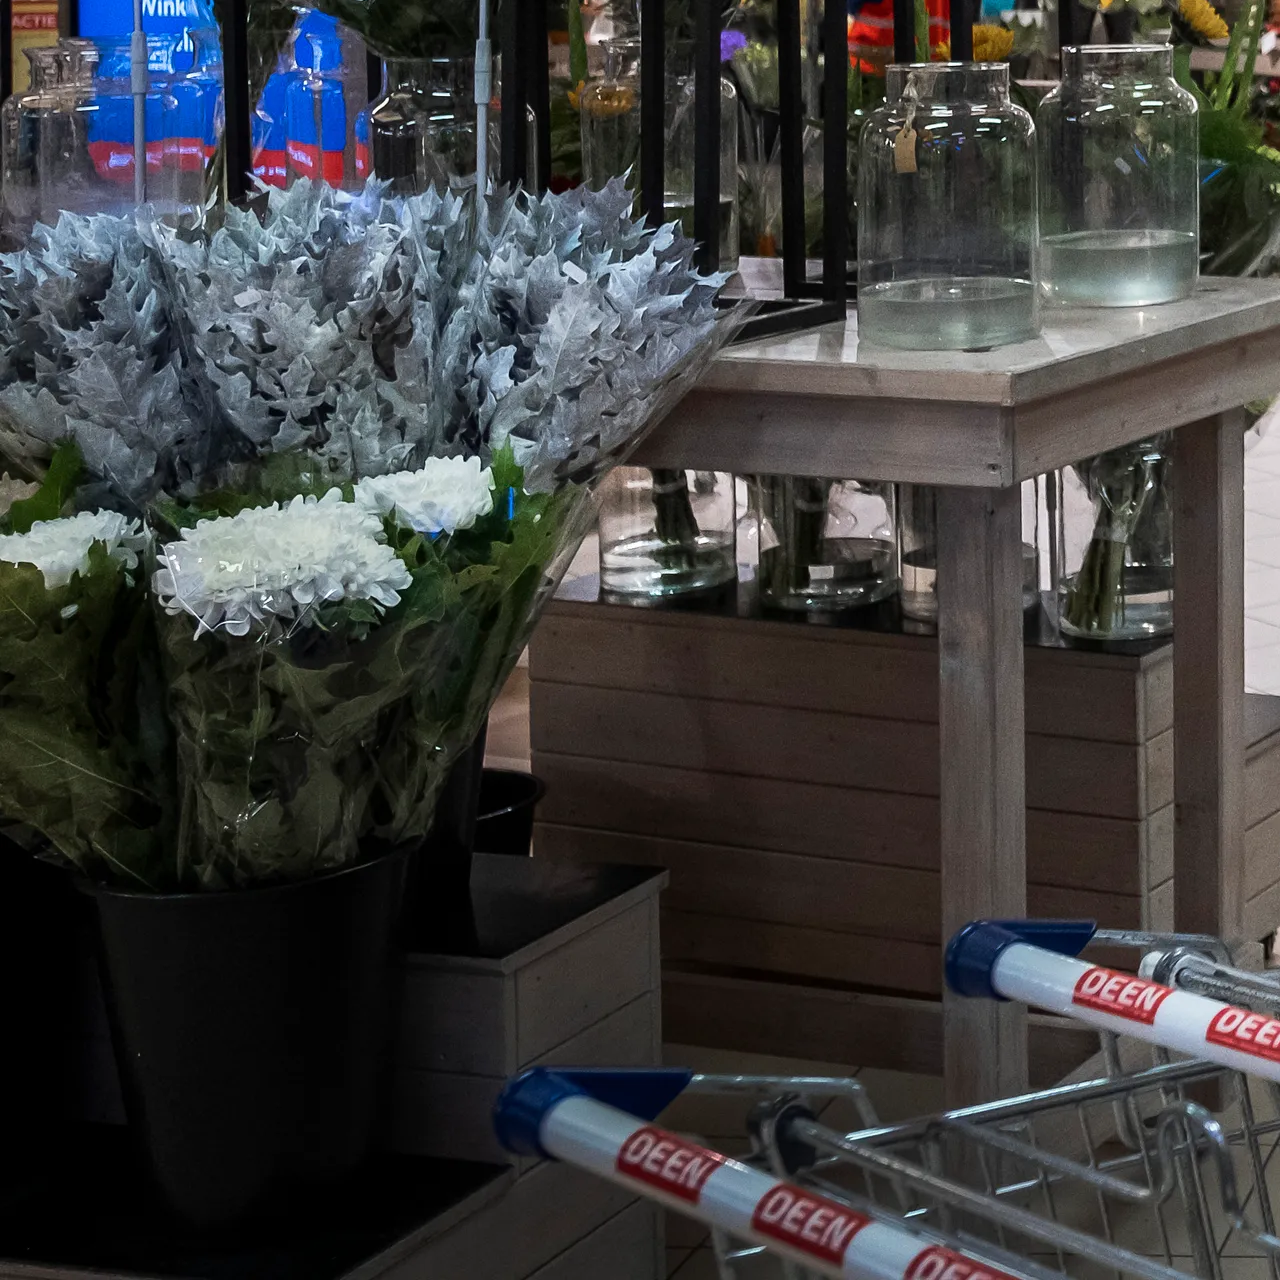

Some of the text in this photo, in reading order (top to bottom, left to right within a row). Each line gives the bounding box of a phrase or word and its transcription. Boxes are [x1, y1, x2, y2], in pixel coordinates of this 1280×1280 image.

[1080, 969, 1170, 1011] DEEN
[625, 1135, 713, 1190] DEEN
[760, 1190, 855, 1251] DEEN
